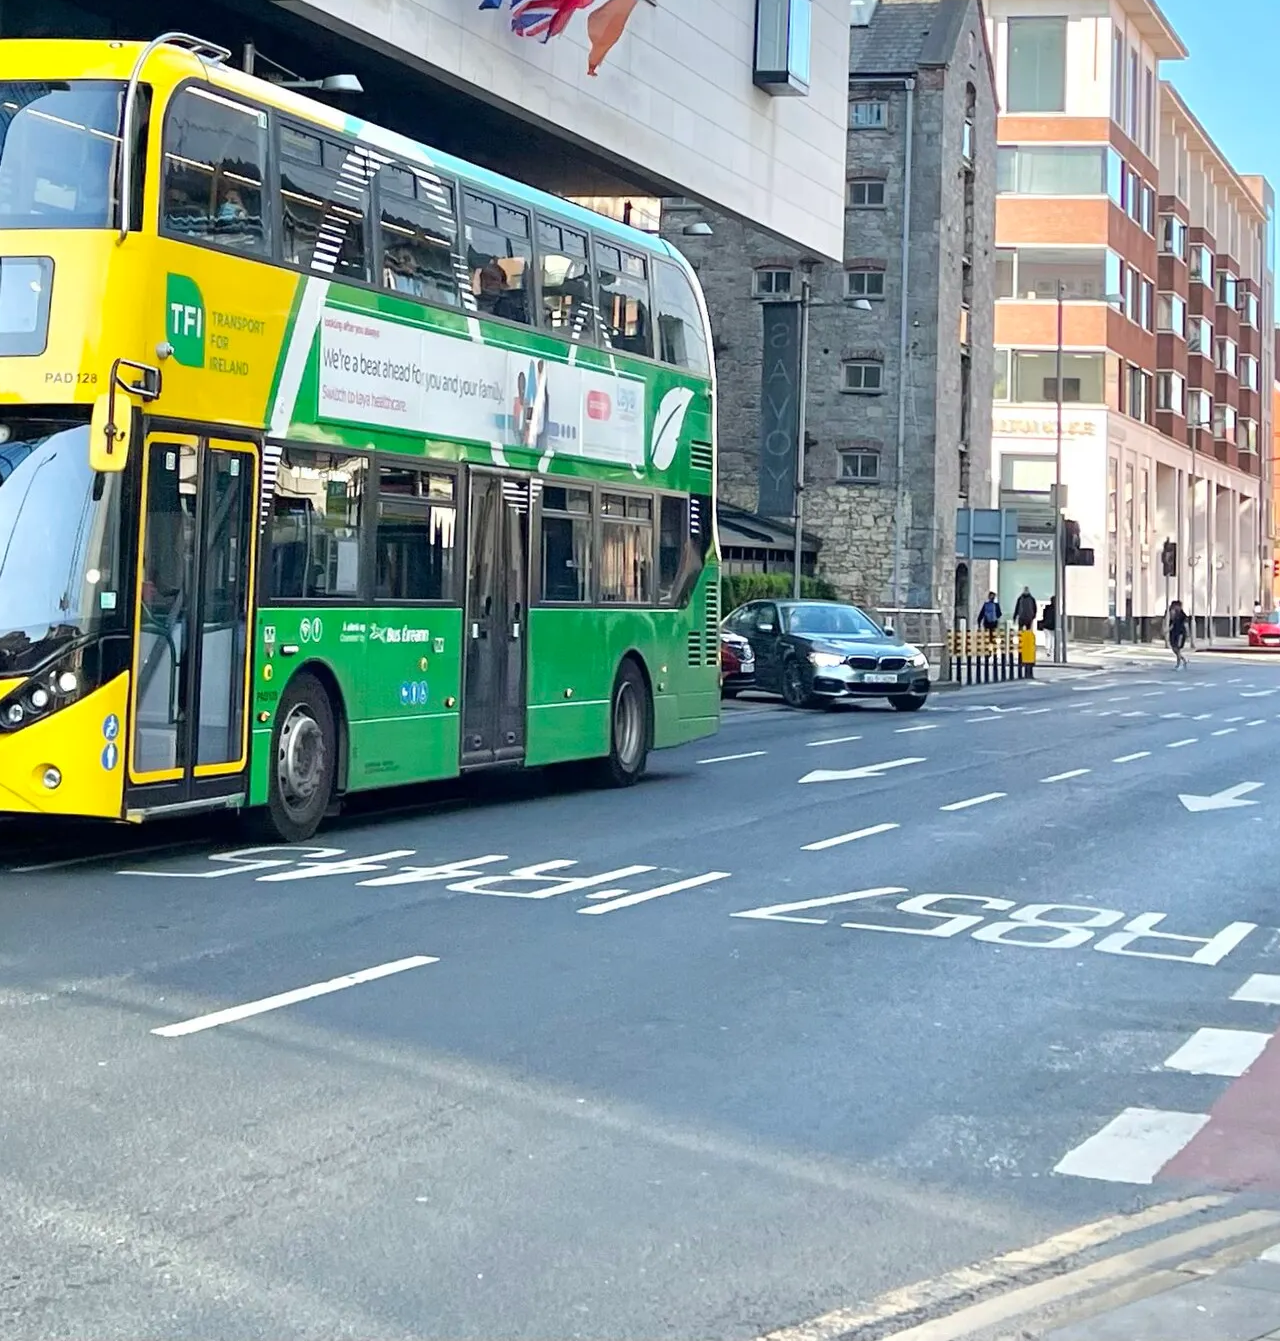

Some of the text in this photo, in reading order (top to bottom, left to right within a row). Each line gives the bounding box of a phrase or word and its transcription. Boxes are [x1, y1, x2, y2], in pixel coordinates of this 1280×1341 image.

[171, 303, 202, 338] TFI
[212, 311, 266, 336] TRANSPORT
[210, 334, 229, 349] FOR
[209, 357, 249, 376] IRELAND
[323, 346, 351, 371] We're
[352, 356, 359, 372] a
[360, 353, 381, 377] beat
[382, 359, 410, 382] ahead
[425, 371, 441, 392] you
[442, 374, 458, 393] and
[459, 378, 478, 398] your
[45, 373, 98, 383] PAD 128
[1016, 538, 1053, 550] MPM
[386, 627, 401, 642] Bus
[730, 886, 1258, 966] R857
